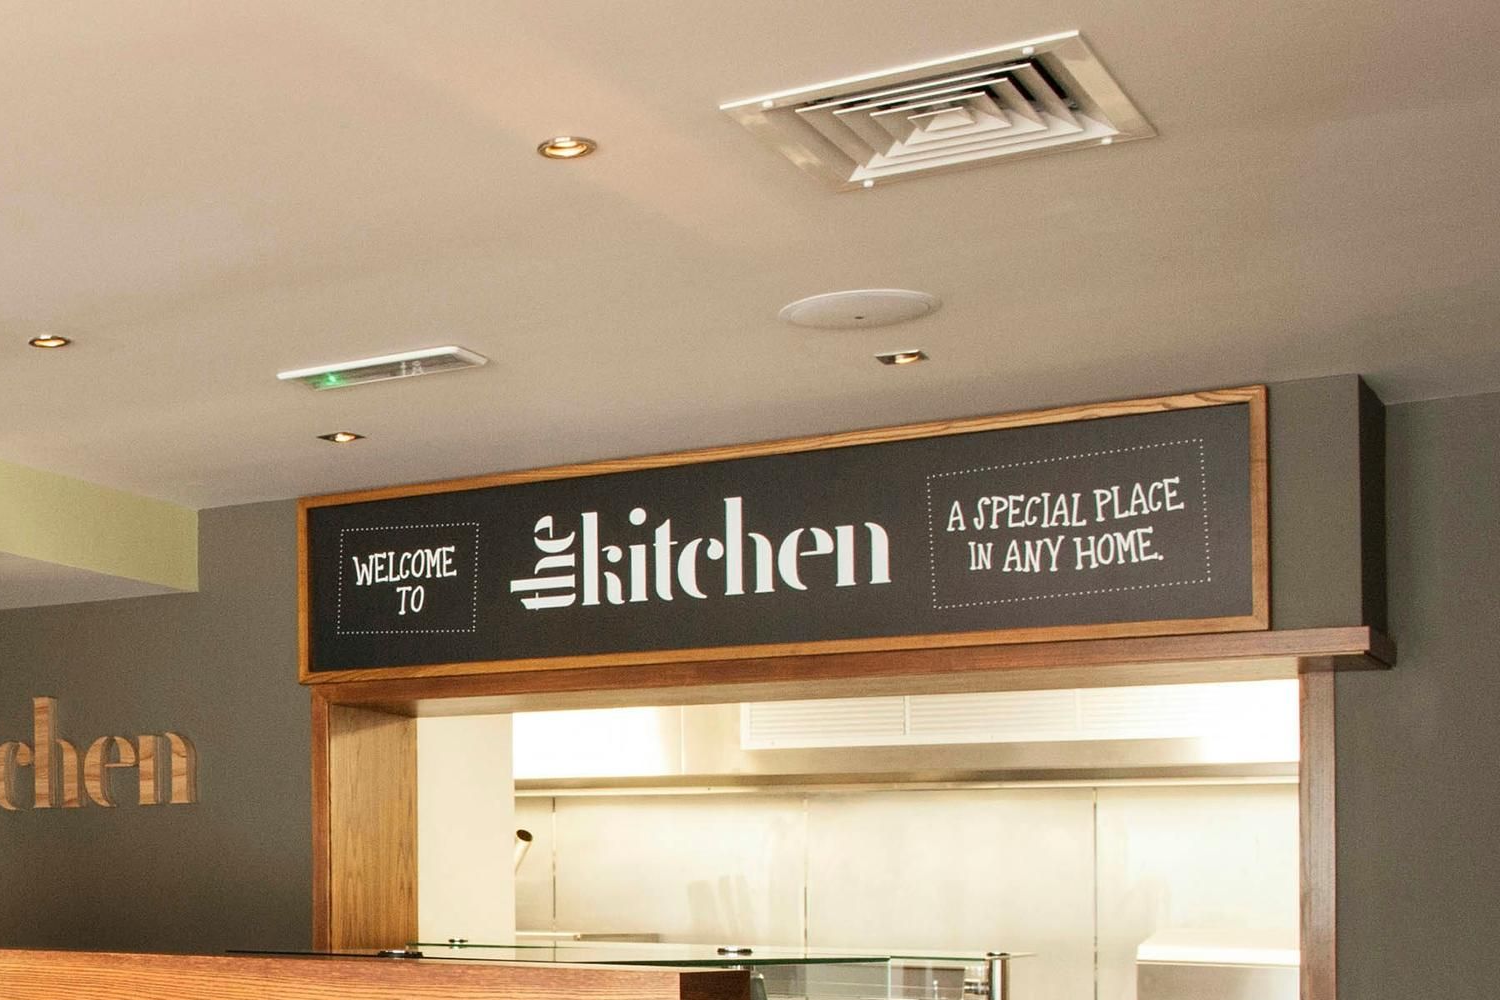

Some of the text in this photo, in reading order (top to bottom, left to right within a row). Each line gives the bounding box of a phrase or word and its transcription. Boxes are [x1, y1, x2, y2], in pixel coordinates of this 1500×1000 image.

[946, 476, 1185, 532] A SPECIAL PLACE
[352, 545, 457, 586] WELCOME
[510, 496, 892, 611] the kitchen
[968, 526, 1164, 573] IN ANY HOME.
[396, 585, 425, 616] TO
